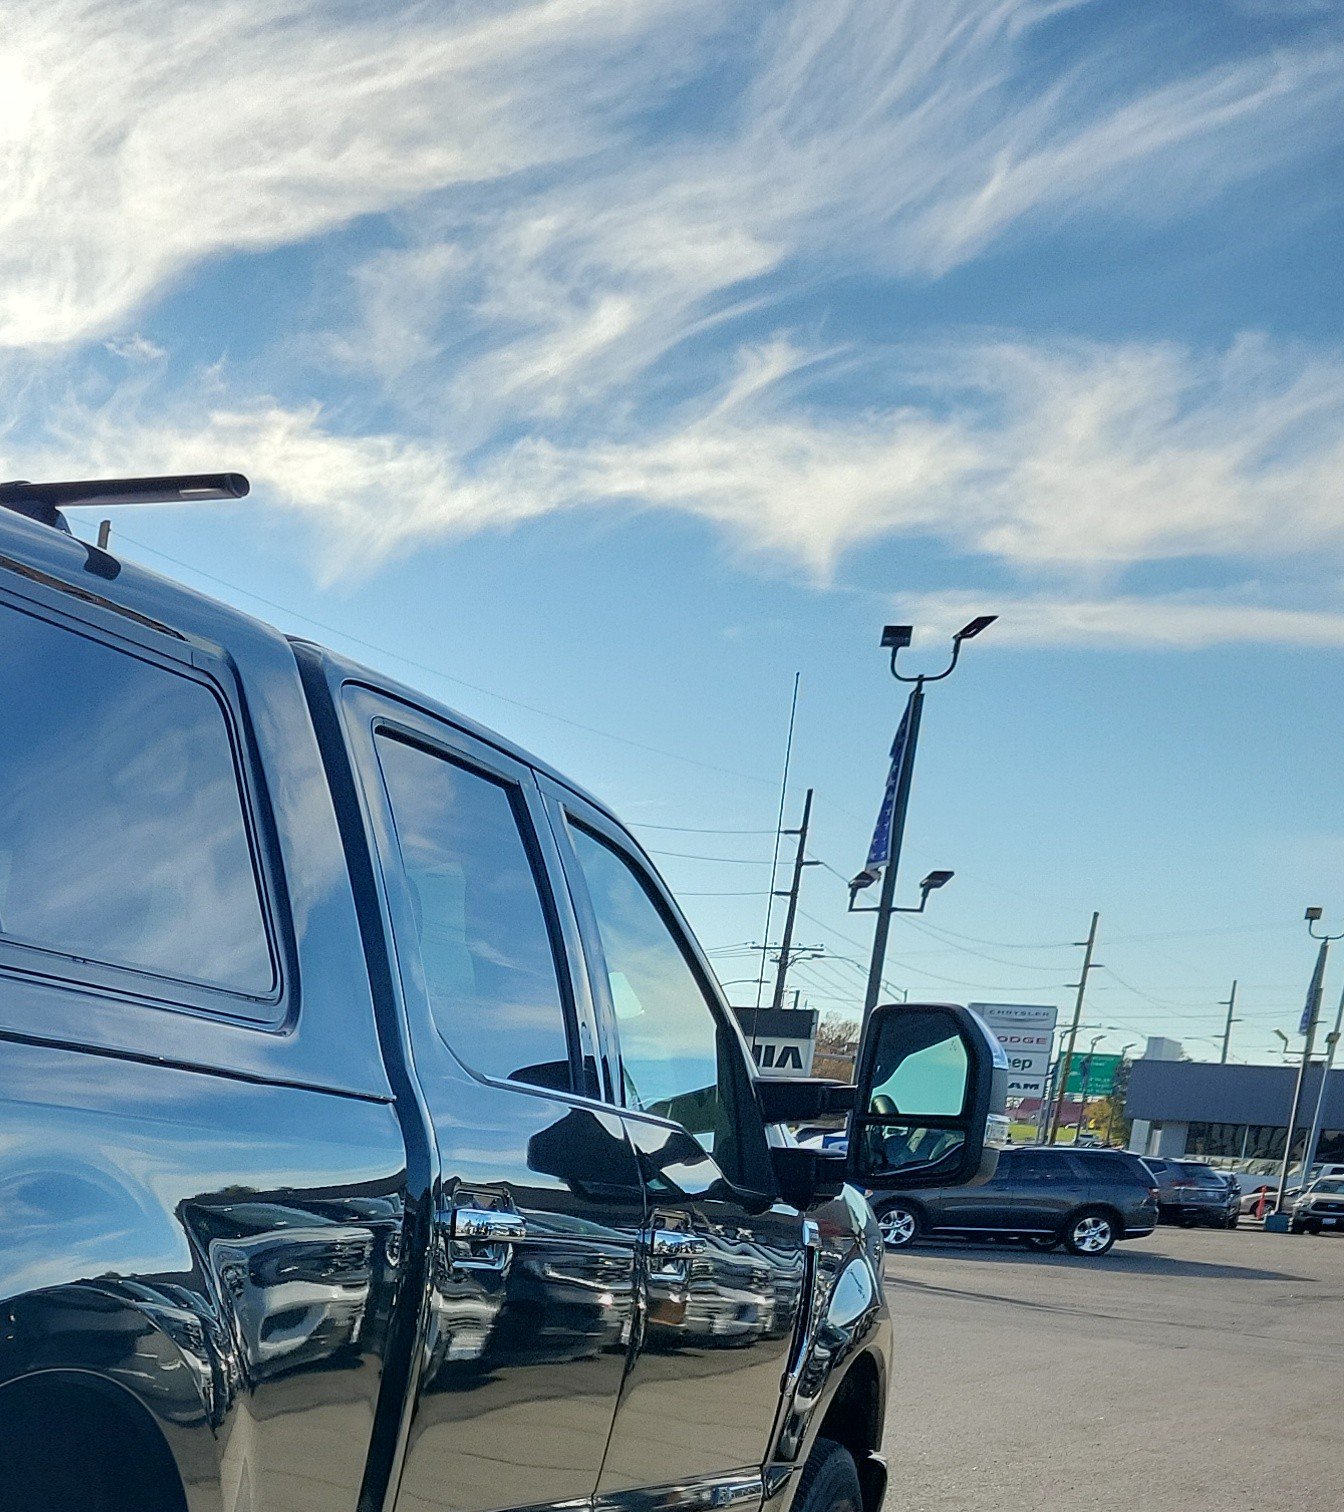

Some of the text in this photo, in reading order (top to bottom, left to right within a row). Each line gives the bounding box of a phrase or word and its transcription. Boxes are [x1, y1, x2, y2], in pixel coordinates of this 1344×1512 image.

[989, 1009, 1050, 1017] CHRYSLER
[997, 1035, 1048, 1045] ODGE
[1008, 1057, 1032, 1071] ep
[1008, 1082, 1040, 1091] AM
